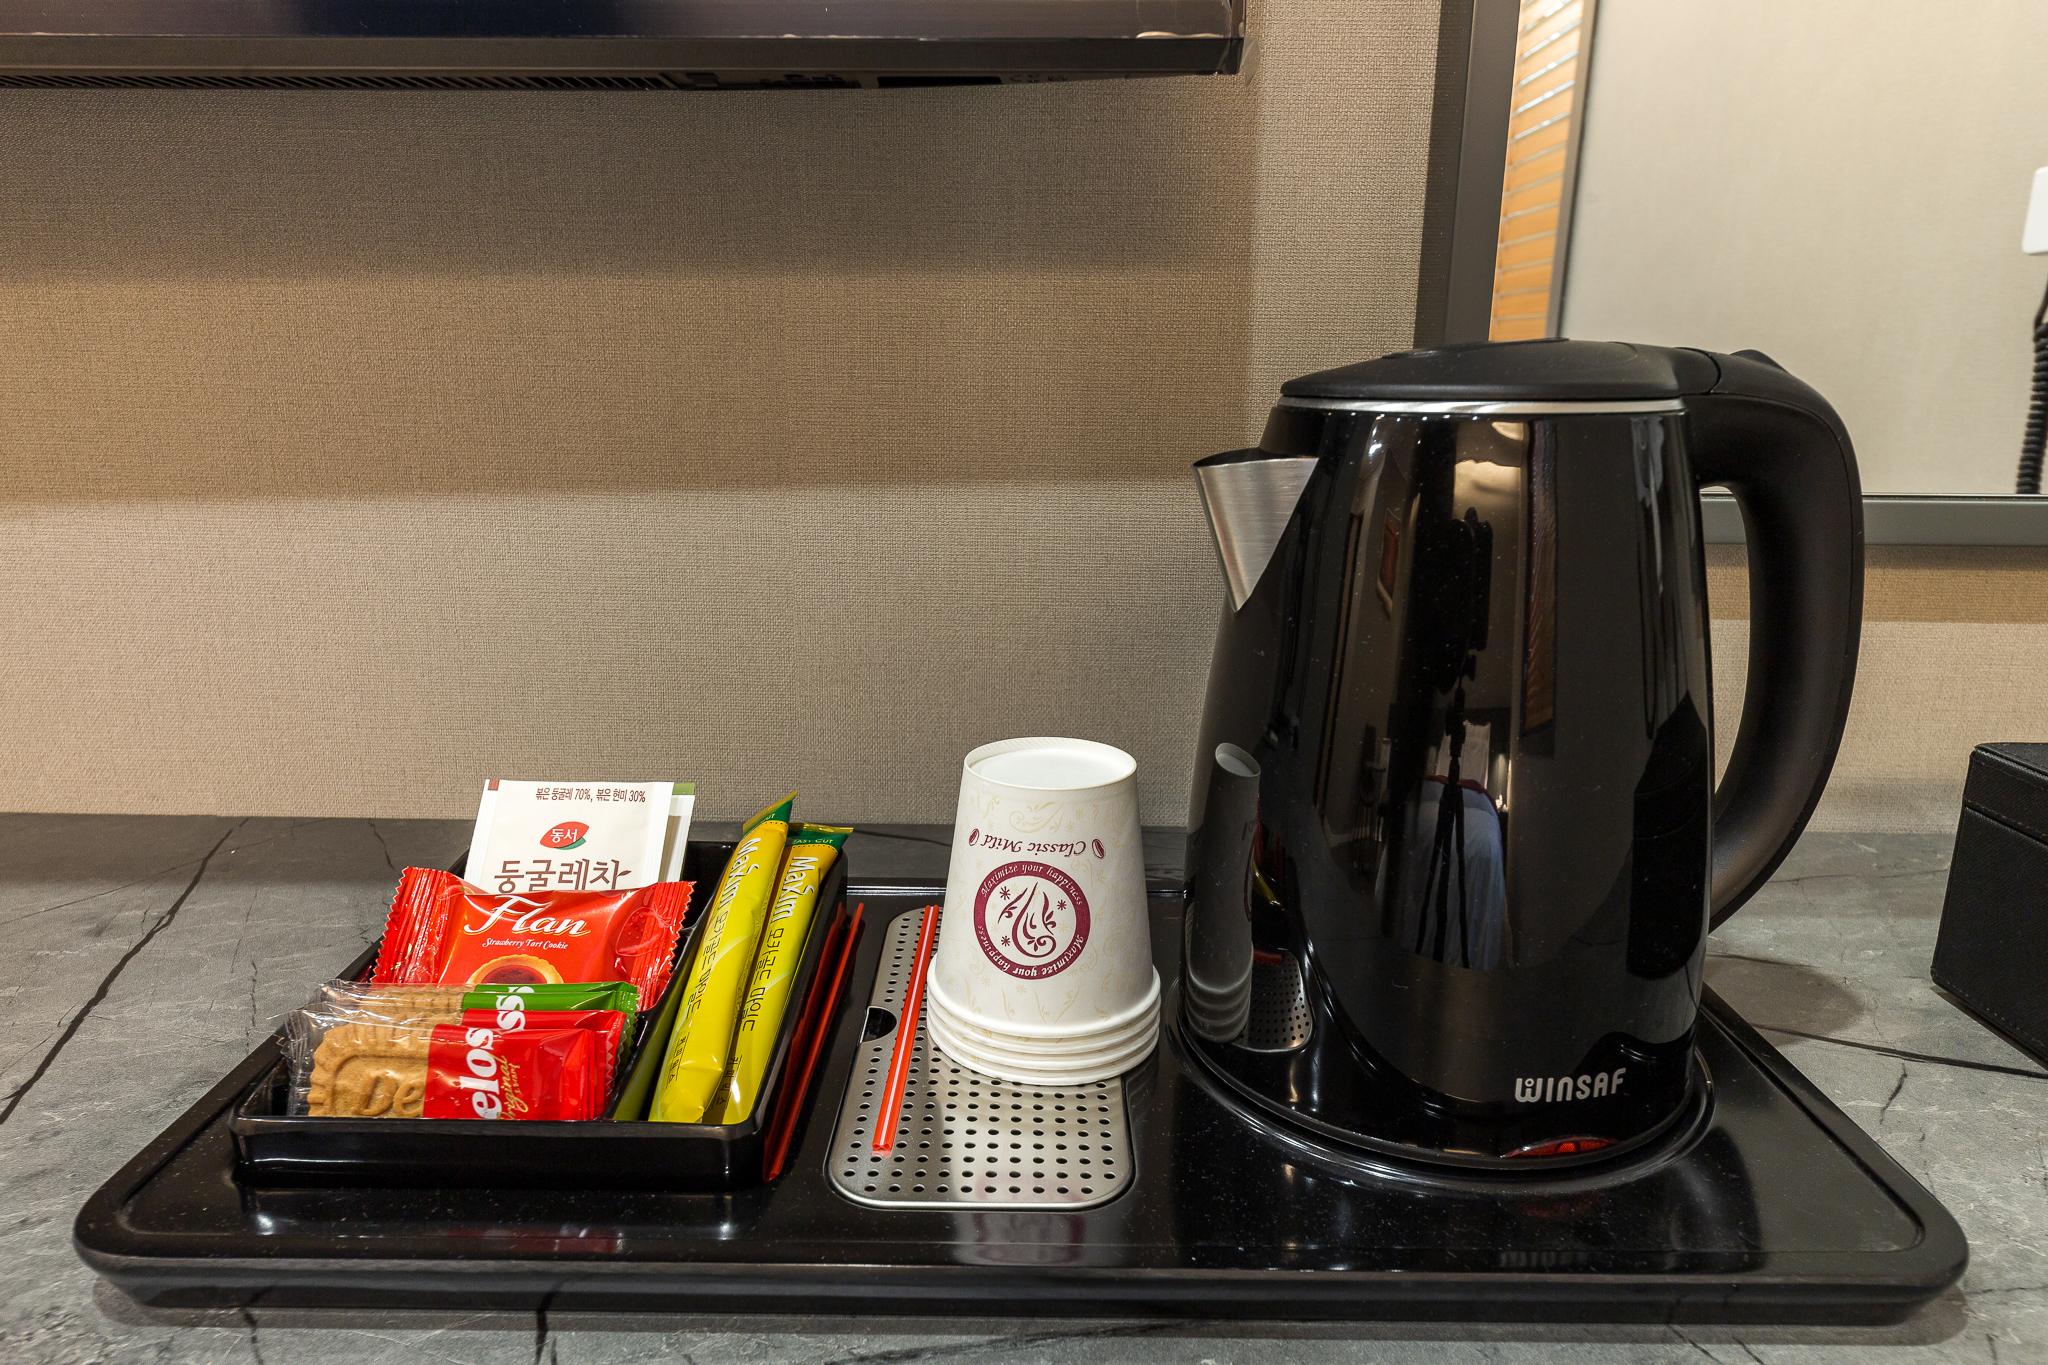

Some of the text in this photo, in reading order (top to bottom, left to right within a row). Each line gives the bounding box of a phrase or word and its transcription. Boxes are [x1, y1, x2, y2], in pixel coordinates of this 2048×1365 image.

[574, 788, 594, 803] 70%,
[612, 788, 627, 803] 현미
[628, 790, 646, 803] 30%
[550, 828, 579, 844] 동서
[980, 833, 1087, 858] Classic Mild
[494, 858, 631, 894] 둥굴레차
[717, 837, 762, 912] Maxim
[1021, 863, 1044, 874] your
[771, 856, 820, 924] Maxim
[463, 893, 592, 936] Flan
[481, 937, 569, 950] Strawberry Tart Cookie
[1041, 934, 1085, 976] Maximize
[1012, 965, 1038, 977] your
[741, 986, 766, 1032] 마일드
[459, 1027, 503, 1120] elos
[1514, 1067, 1627, 1103] WINSAF
